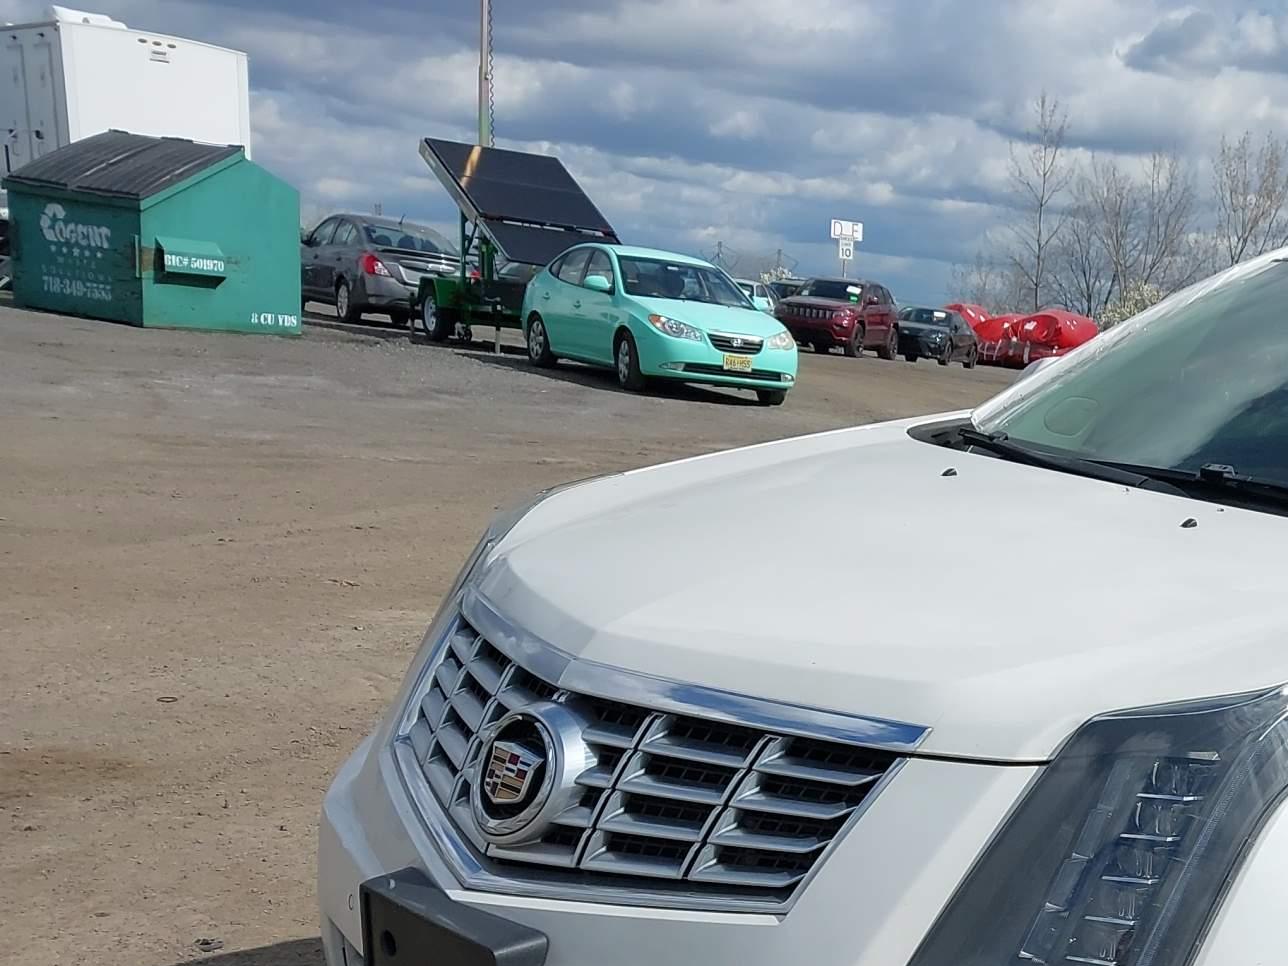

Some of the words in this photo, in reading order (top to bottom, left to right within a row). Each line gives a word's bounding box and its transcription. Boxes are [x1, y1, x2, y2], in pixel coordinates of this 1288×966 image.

[841, 248, 851, 257] 10
[191, 257, 225, 271] 501970
[260, 312, 275, 324] CU
[277, 314, 297, 327] YDS
